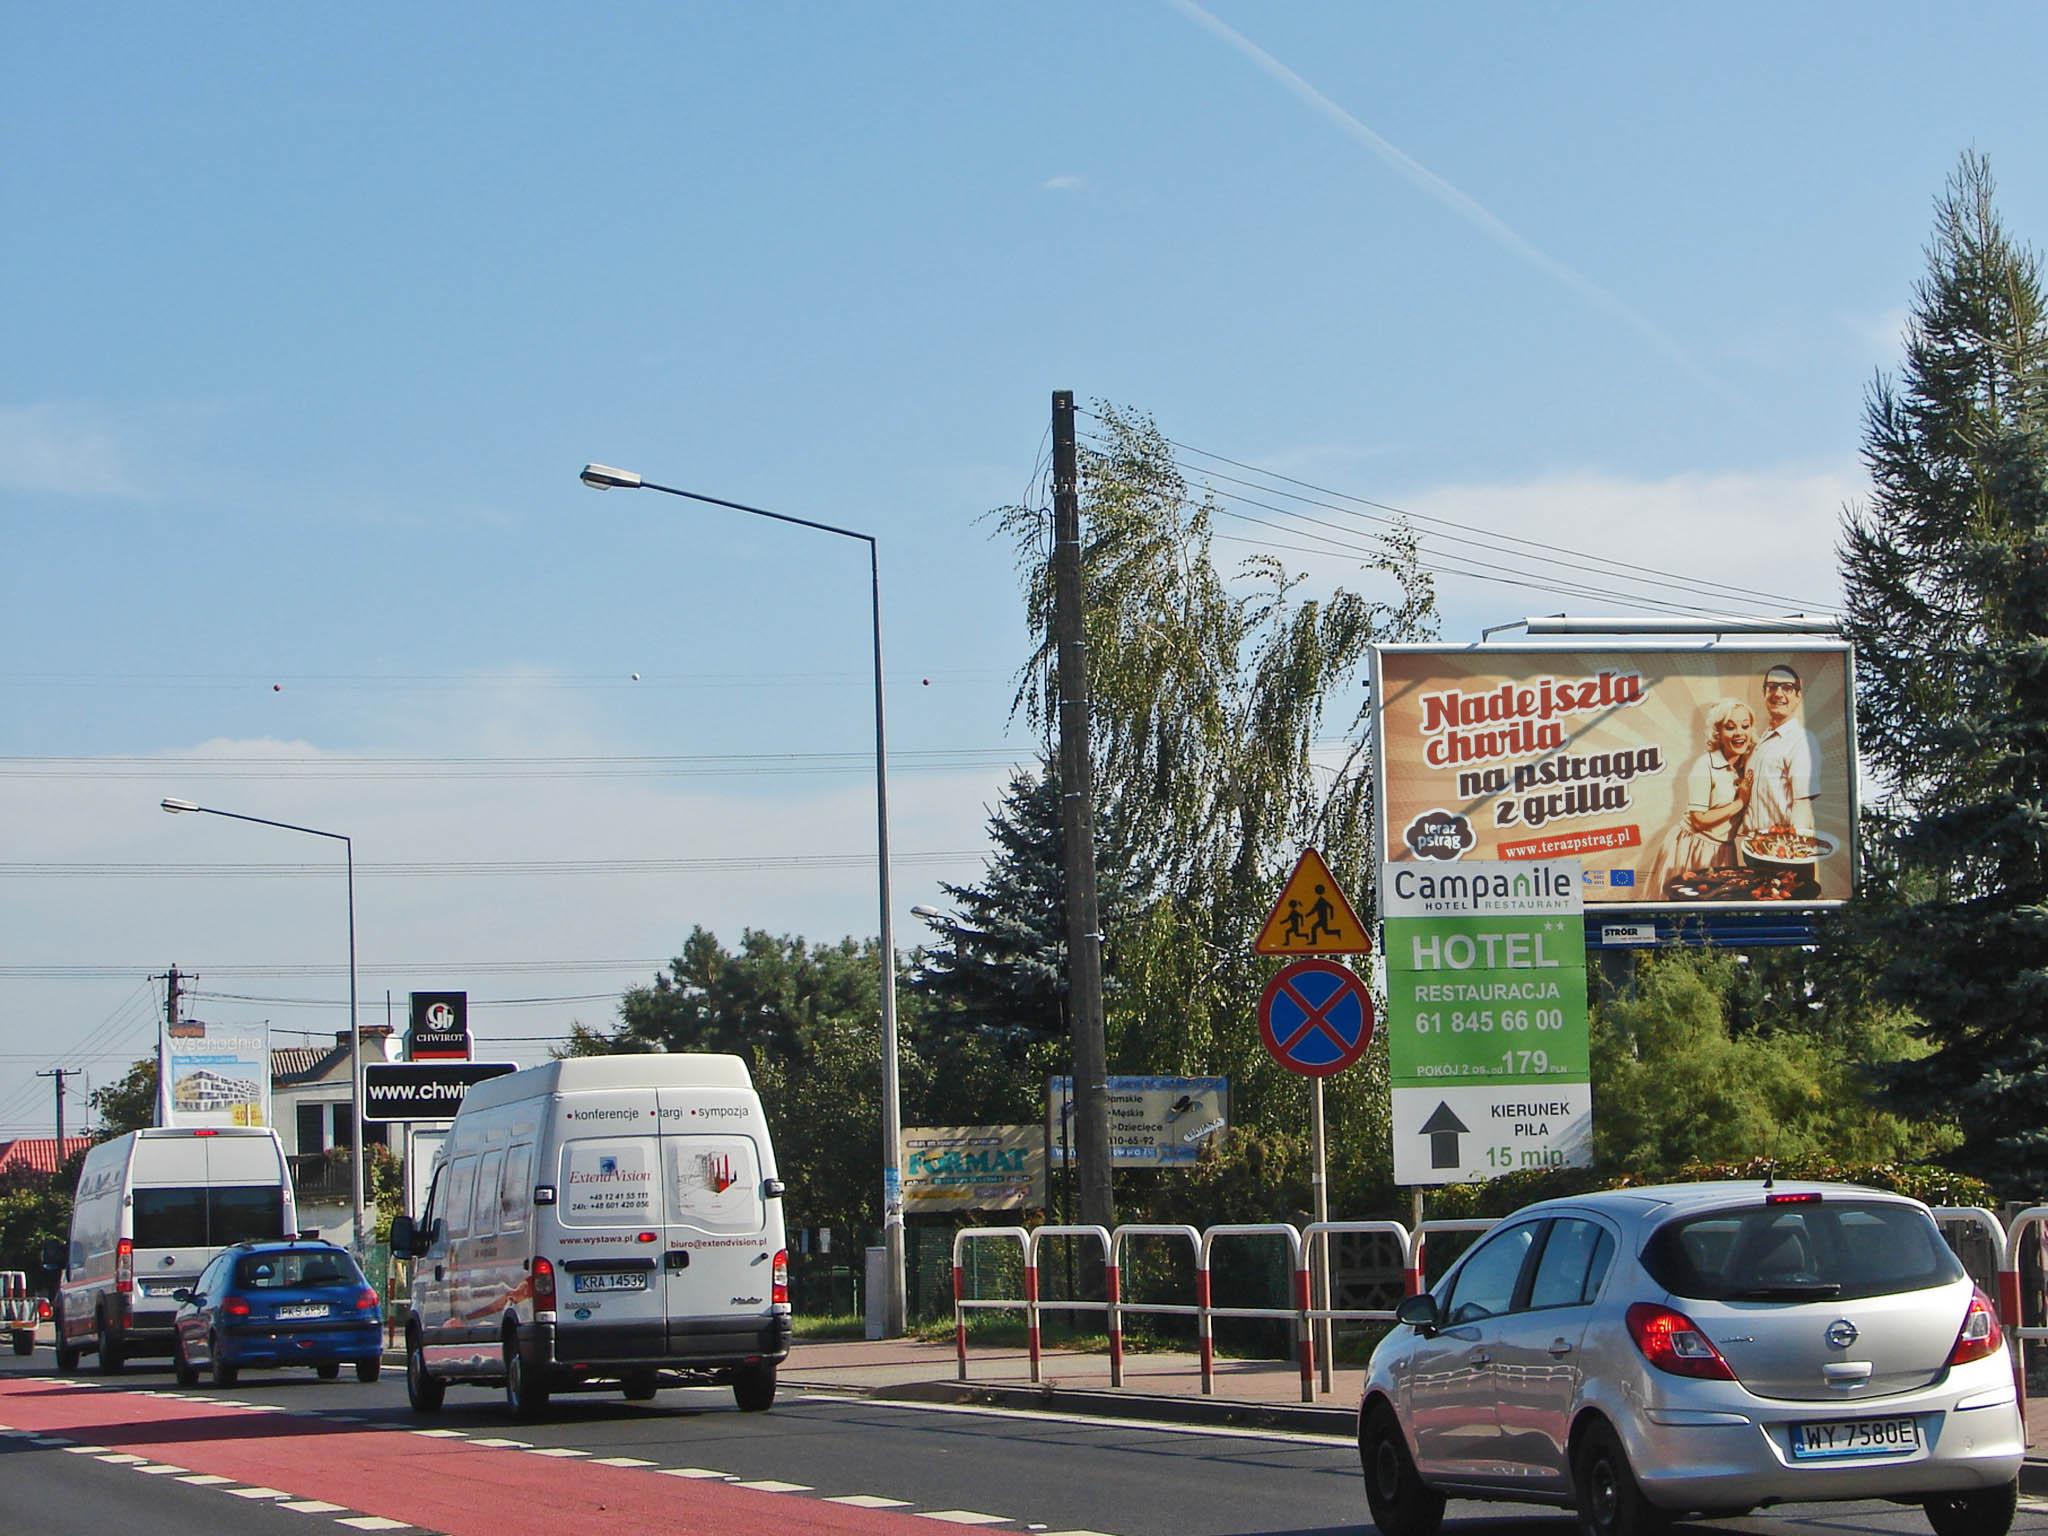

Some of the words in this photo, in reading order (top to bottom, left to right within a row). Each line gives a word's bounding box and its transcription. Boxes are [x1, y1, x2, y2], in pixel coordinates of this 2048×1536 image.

[1426, 719, 1565, 766] chwila
[1459, 768, 1507, 798] na
[1496, 799, 1518, 824] z
[1526, 780, 1629, 823] grilla
[1424, 822, 1457, 835] teraz
[1505, 832, 1631, 858] www.terazpstrag.pl
[1395, 867, 1571, 909] Campanile
[1425, 902, 1468, 911] HOTEL
[1484, 900, 1570, 910] RESTAURANT
[1412, 933, 1560, 970] HOTEL
[1415, 983, 1560, 1002] RESTAURACJA
[1415, 1012, 1442, 1034] 61
[1451, 1011, 1494, 1033] 845
[1501, 1010, 1529, 1032] 66
[1535, 1008, 1563, 1031] 00
[416, 1033, 464, 1043] CHWIROT
[1462, 1063, 1469, 1074] 2
[1501, 1050, 1548, 1074] 179
[1550, 1065, 1569, 1073] PLN
[369, 1081, 471, 1100] www.chwir
[574, 1107, 639, 1122] konferencje
[658, 1106, 683, 1119] targi
[698, 1105, 749, 1118] sympozja
[1491, 1102, 1570, 1118] KIERUNEK
[908, 1147, 1030, 1176] FORMAT
[1487, 1148, 1513, 1168] 15
[1520, 1144, 1571, 1168] min.
[560, 1234, 633, 1245] www.wystawa.pl
[671, 1238, 768, 1248] biuro@extendvision.pl
[583, 1276, 606, 1289] KRA
[611, 1274, 645, 1287] 14539
[1805, 1425, 1836, 1450] WY
[1844, 1420, 1914, 1448] 7580E
